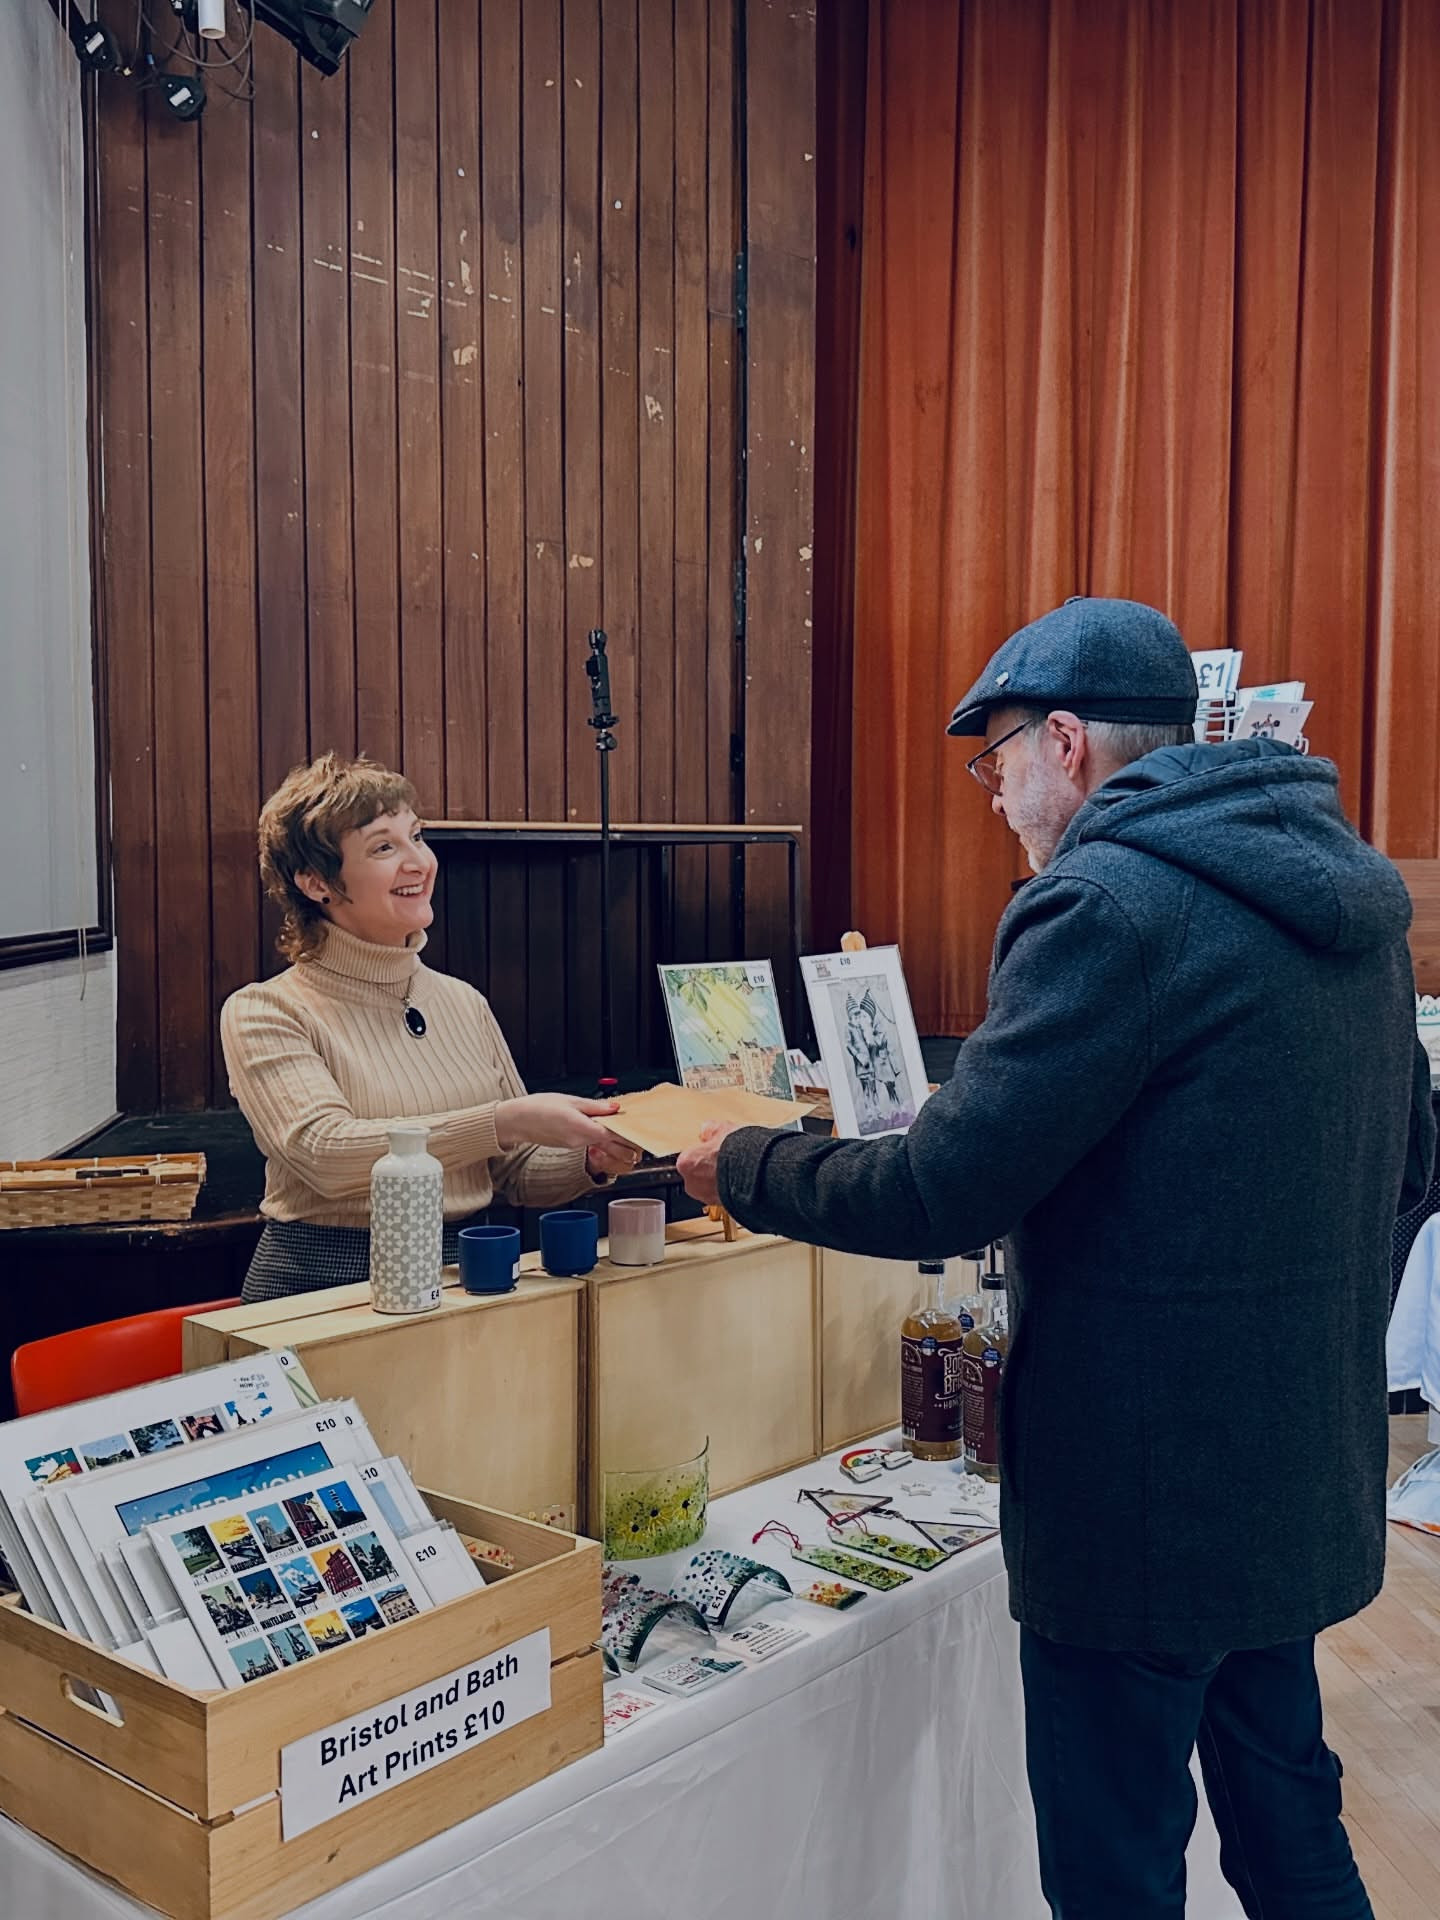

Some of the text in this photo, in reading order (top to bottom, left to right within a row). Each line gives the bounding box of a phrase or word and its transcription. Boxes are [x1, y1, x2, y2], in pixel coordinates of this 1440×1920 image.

[1198, 662, 1226, 688] £1
[753, 975, 765, 984] £10
[316, 1418, 337, 1433] £10
[415, 1545, 437, 1562] £10
[711, 1589, 727, 1609] £10
[321, 1654, 518, 1766] Bristol and Bath
[338, 1700, 505, 1803] Art Prints £10
